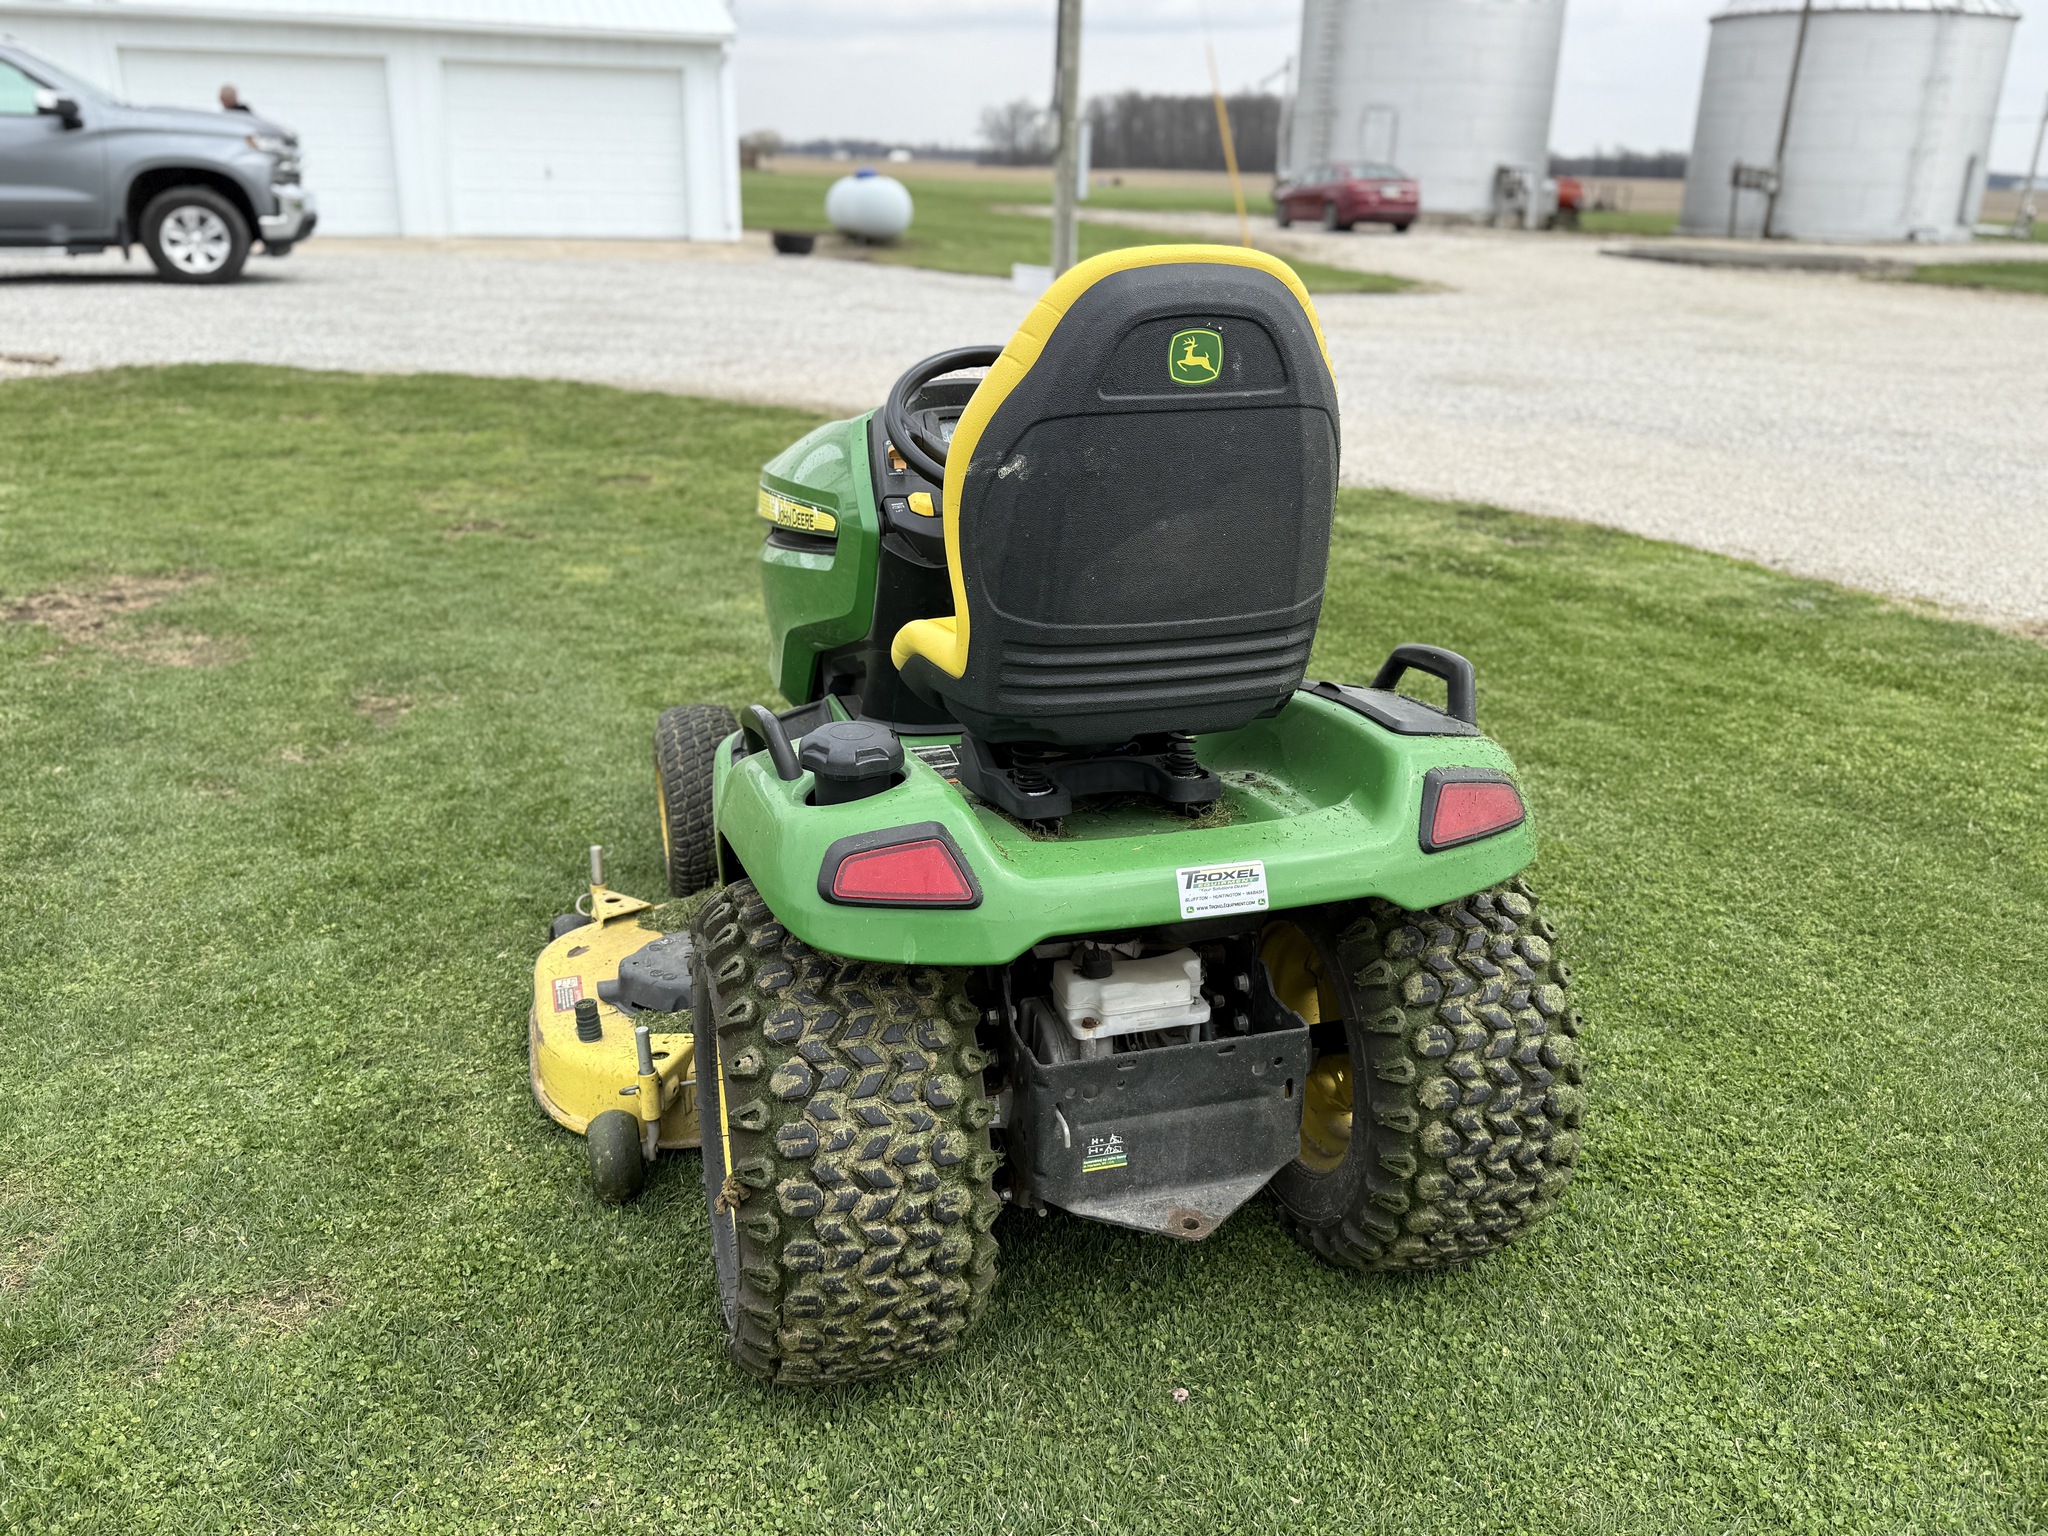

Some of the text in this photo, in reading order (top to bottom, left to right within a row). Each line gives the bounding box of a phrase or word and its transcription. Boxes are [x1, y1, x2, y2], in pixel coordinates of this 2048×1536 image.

[791, 508, 814, 528] DEERE
[1181, 868, 1260, 889] TROXEL
[1198, 878, 1254, 888] EQUIPMENT
[1185, 895, 1209, 903] BLUFFTON
[1213, 892, 1242, 900] HUNTINGTON
